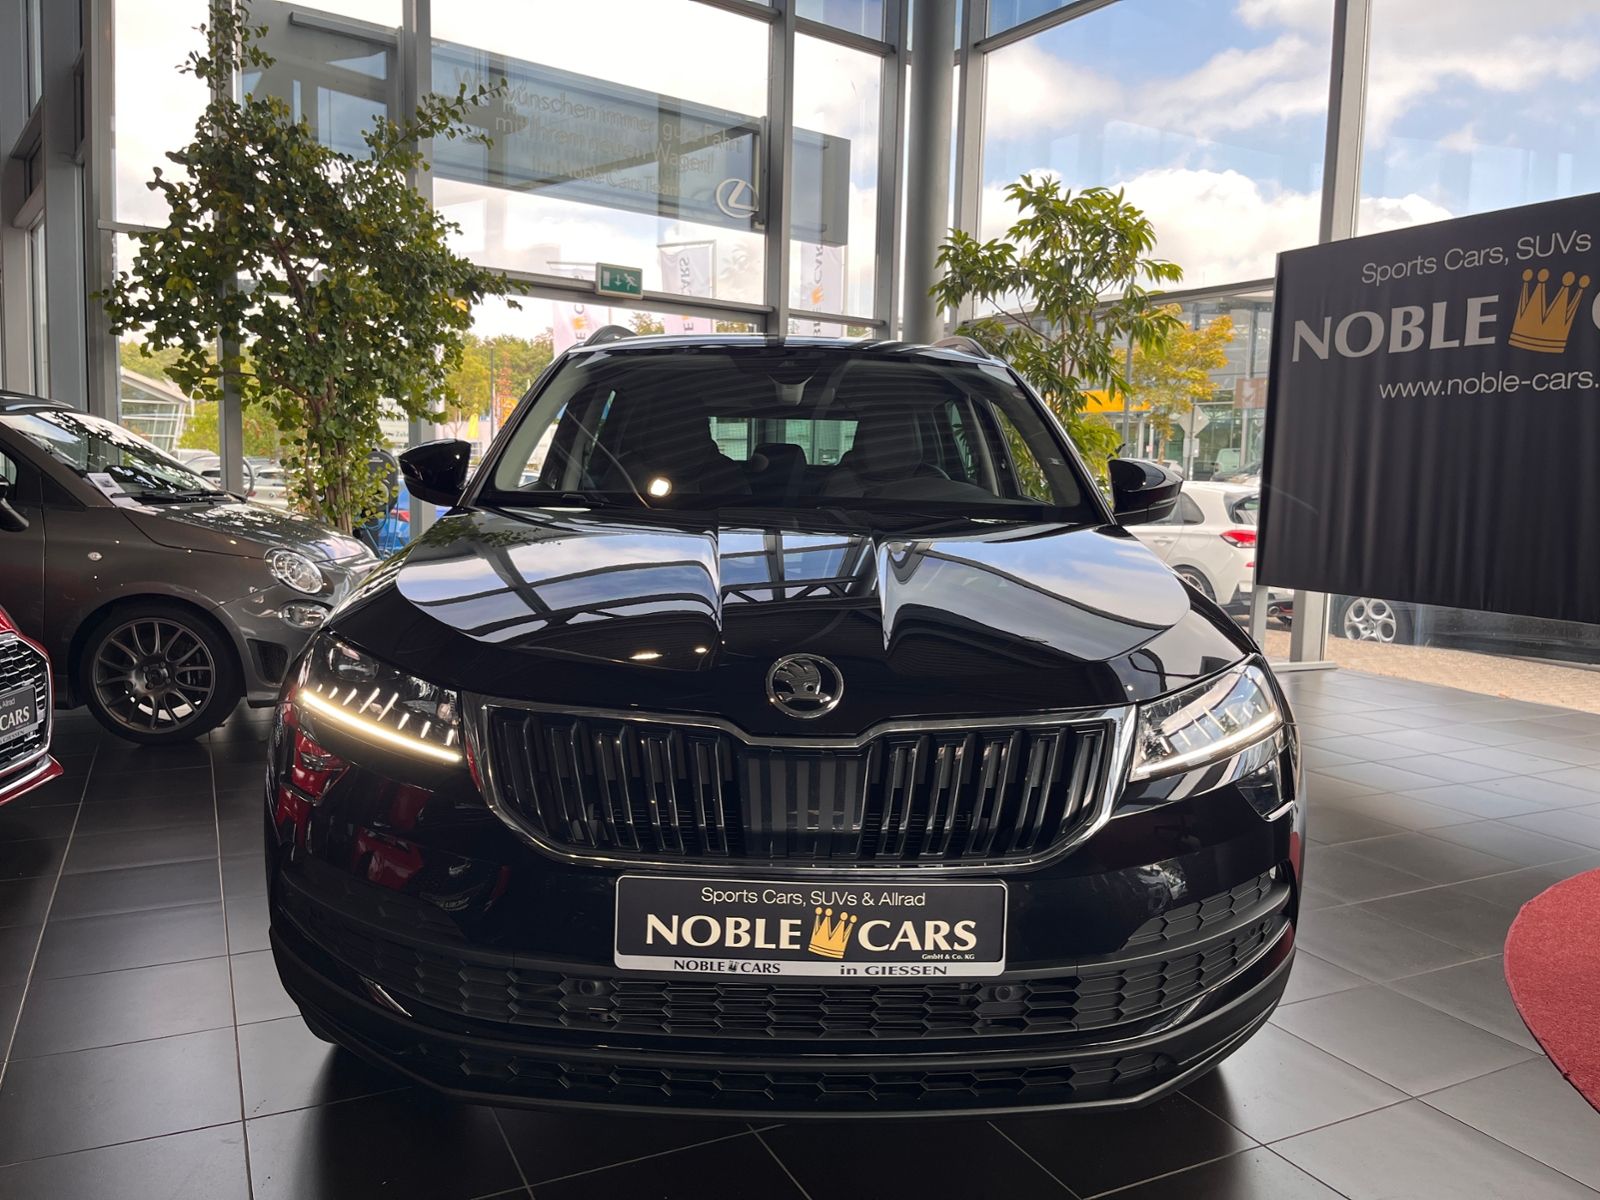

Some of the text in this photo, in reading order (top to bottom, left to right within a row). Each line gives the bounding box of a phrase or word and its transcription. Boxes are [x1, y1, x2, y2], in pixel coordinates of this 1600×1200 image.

[662, 121, 700, 143] gue
[704, 123, 743, 153] Fahrt
[1361, 230, 1592, 287] Sports Cars, SUVs
[1292, 295, 1499, 363] NOBLE
[1379, 370, 1600, 400] www.noble-cars.
[0, 706, 30, 731] CARS
[701, 887, 926, 908] Sports Cars, SUVs & Allrad
[645, 914, 977, 952] NOBLE CARS
[674, 959, 781, 974] NOBLE CARS
[840, 964, 947, 976] in GIESSEN
